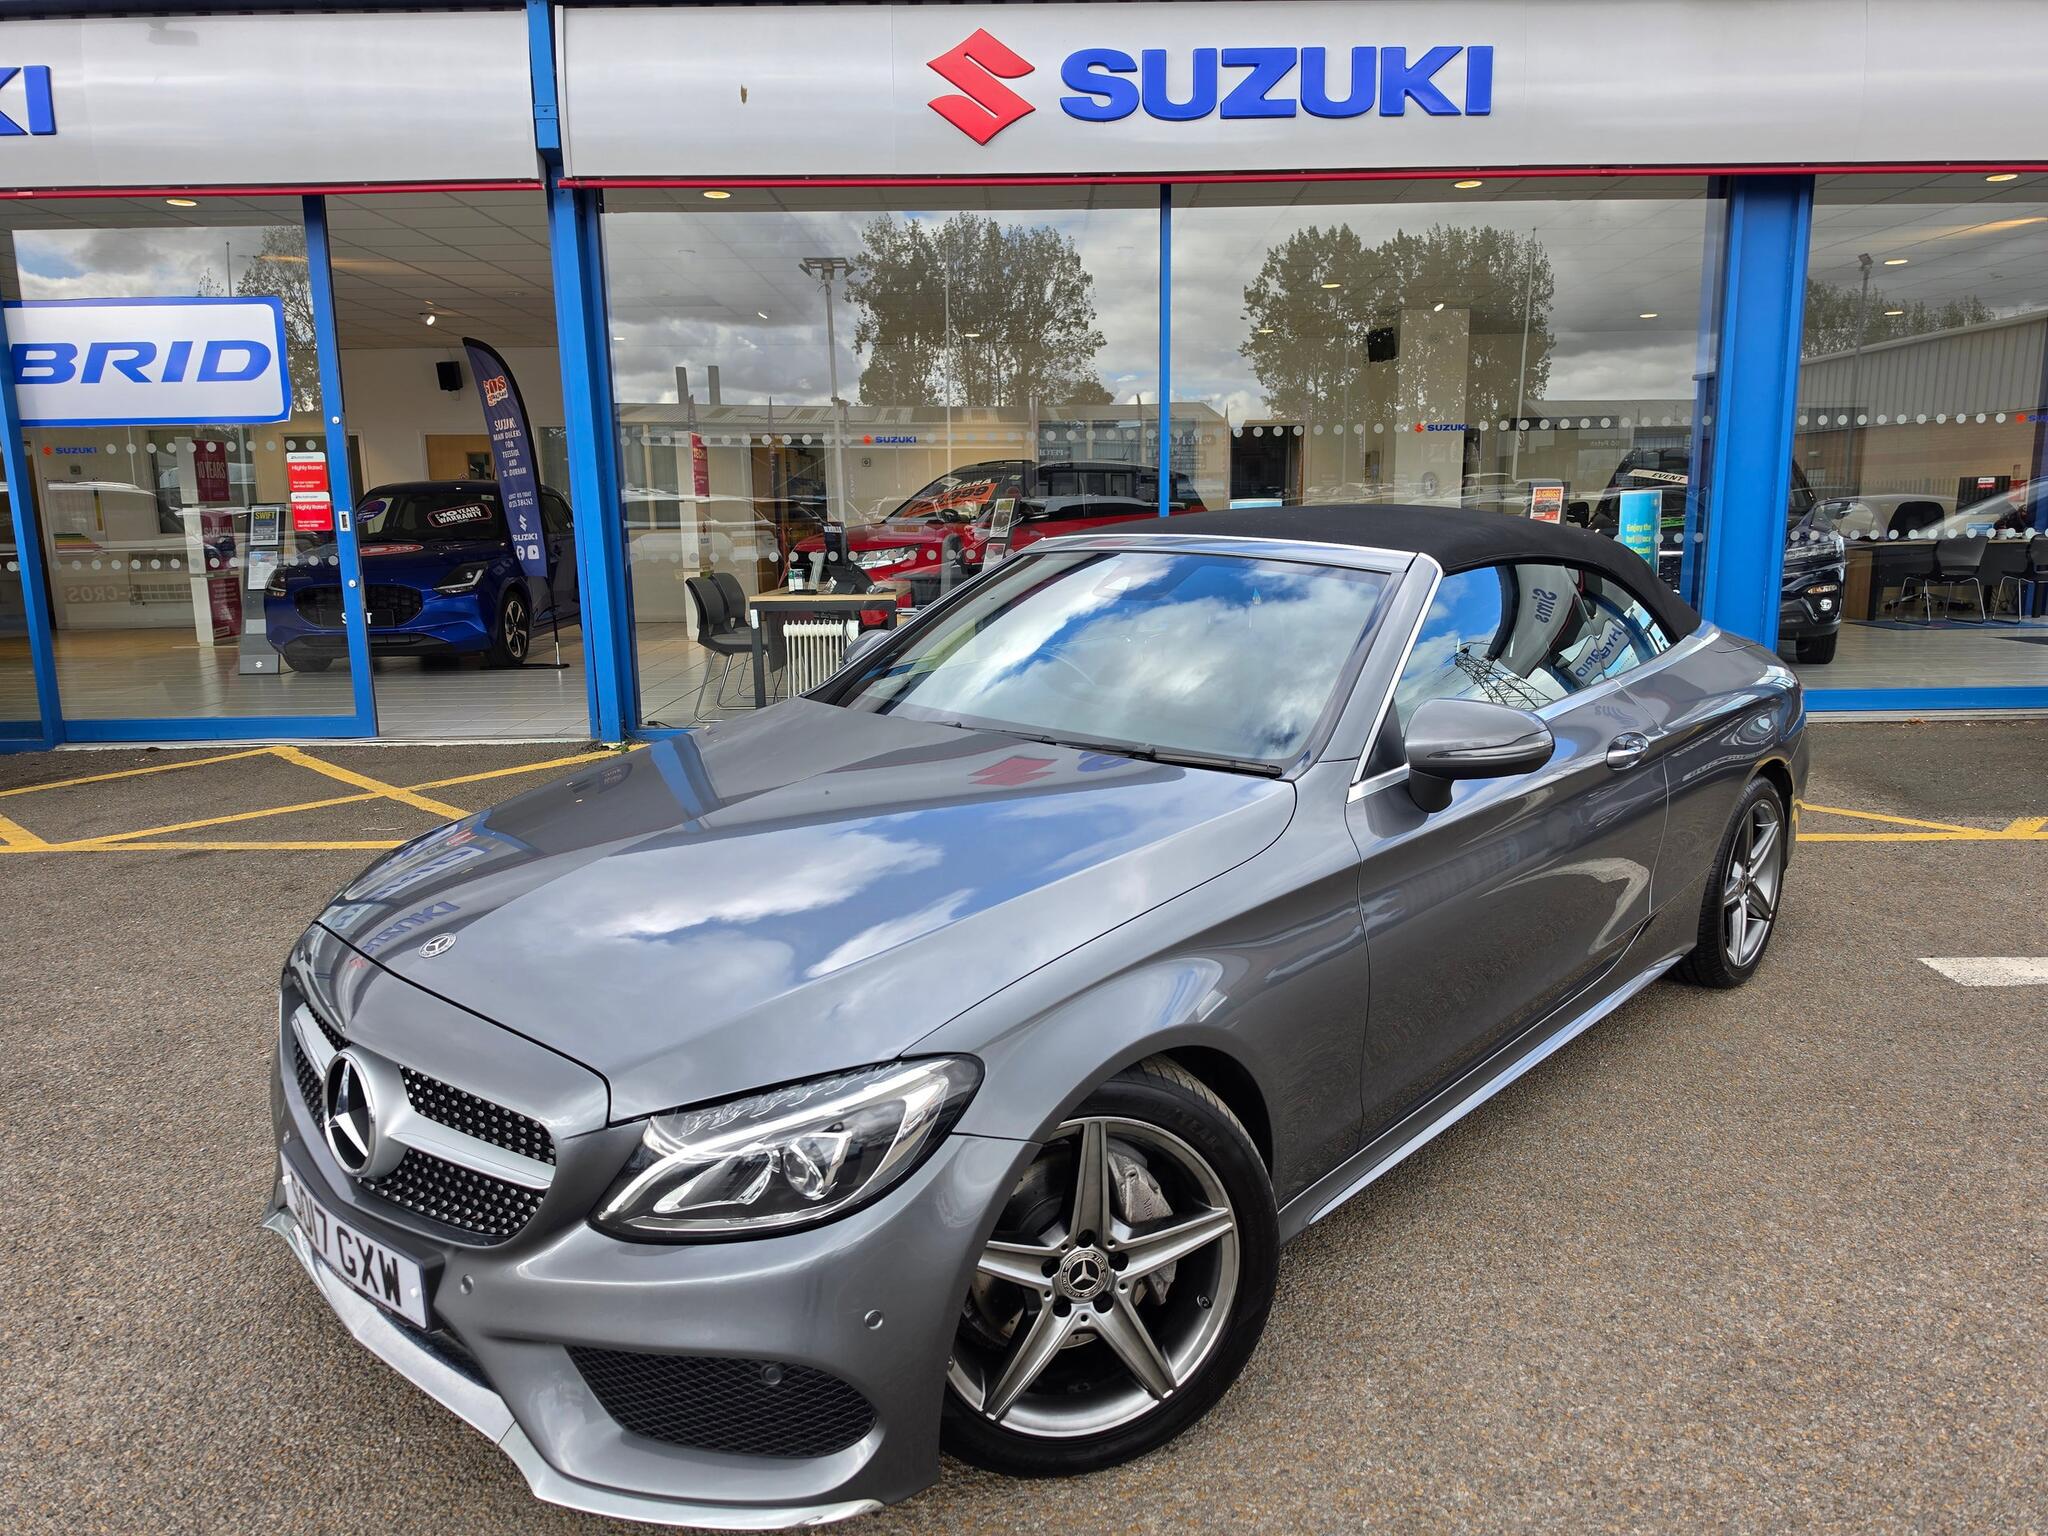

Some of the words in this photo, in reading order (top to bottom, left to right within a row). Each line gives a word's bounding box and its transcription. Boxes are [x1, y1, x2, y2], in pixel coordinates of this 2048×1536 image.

[1060, 45, 1493, 121] SUZUKI
[55, 446, 97, 454] SUZUKI
[205, 461, 226, 478] YEARS
[1652, 472, 1685, 482] EVENT
[457, 505, 480, 514] YEARS
[255, 511, 275, 520] SWIFT
[437, 510, 482, 524] WARRANTY
[512, 533, 537, 541] SUZUKI
[336, 1225, 401, 1308] GXW
